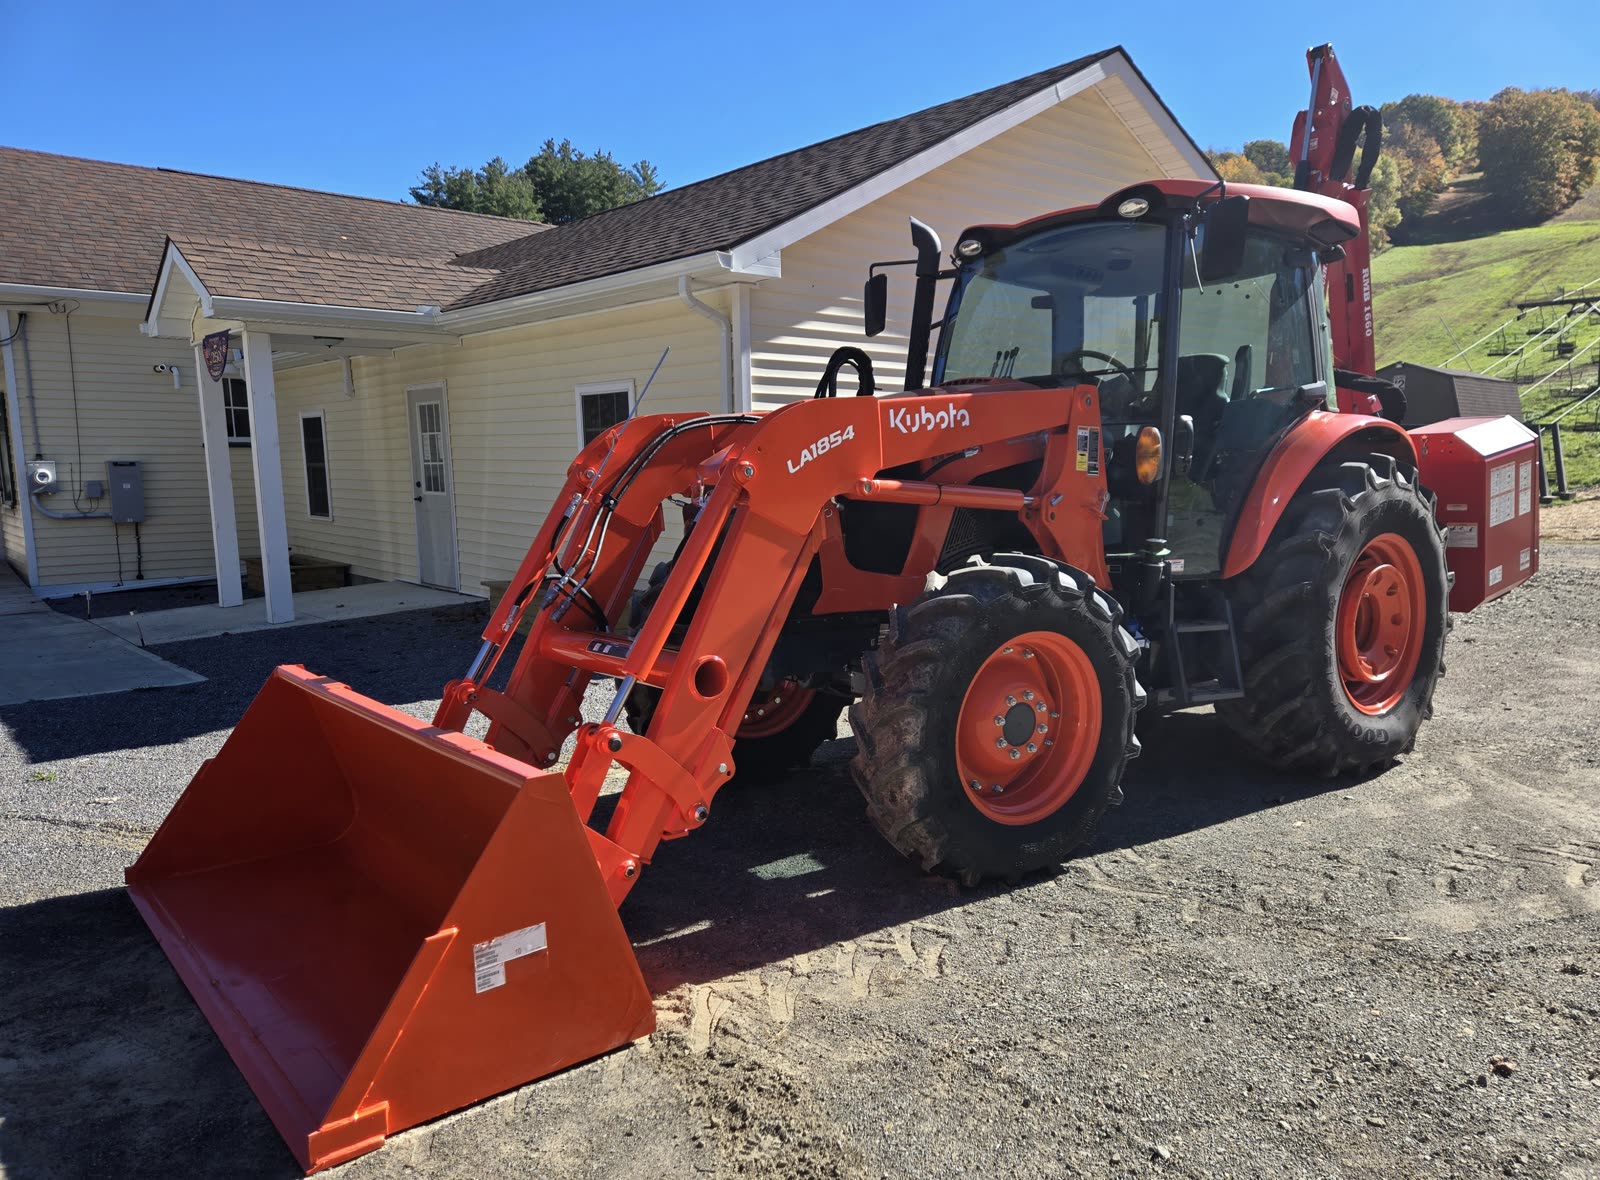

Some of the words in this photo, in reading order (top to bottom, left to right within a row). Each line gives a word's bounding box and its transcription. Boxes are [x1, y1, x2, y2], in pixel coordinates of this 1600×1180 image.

[1362, 267, 1371, 302] RMB
[1364, 305, 1373, 337] 1660
[889, 402, 970, 434] Kubota
[786, 424, 856, 475] LA1854
